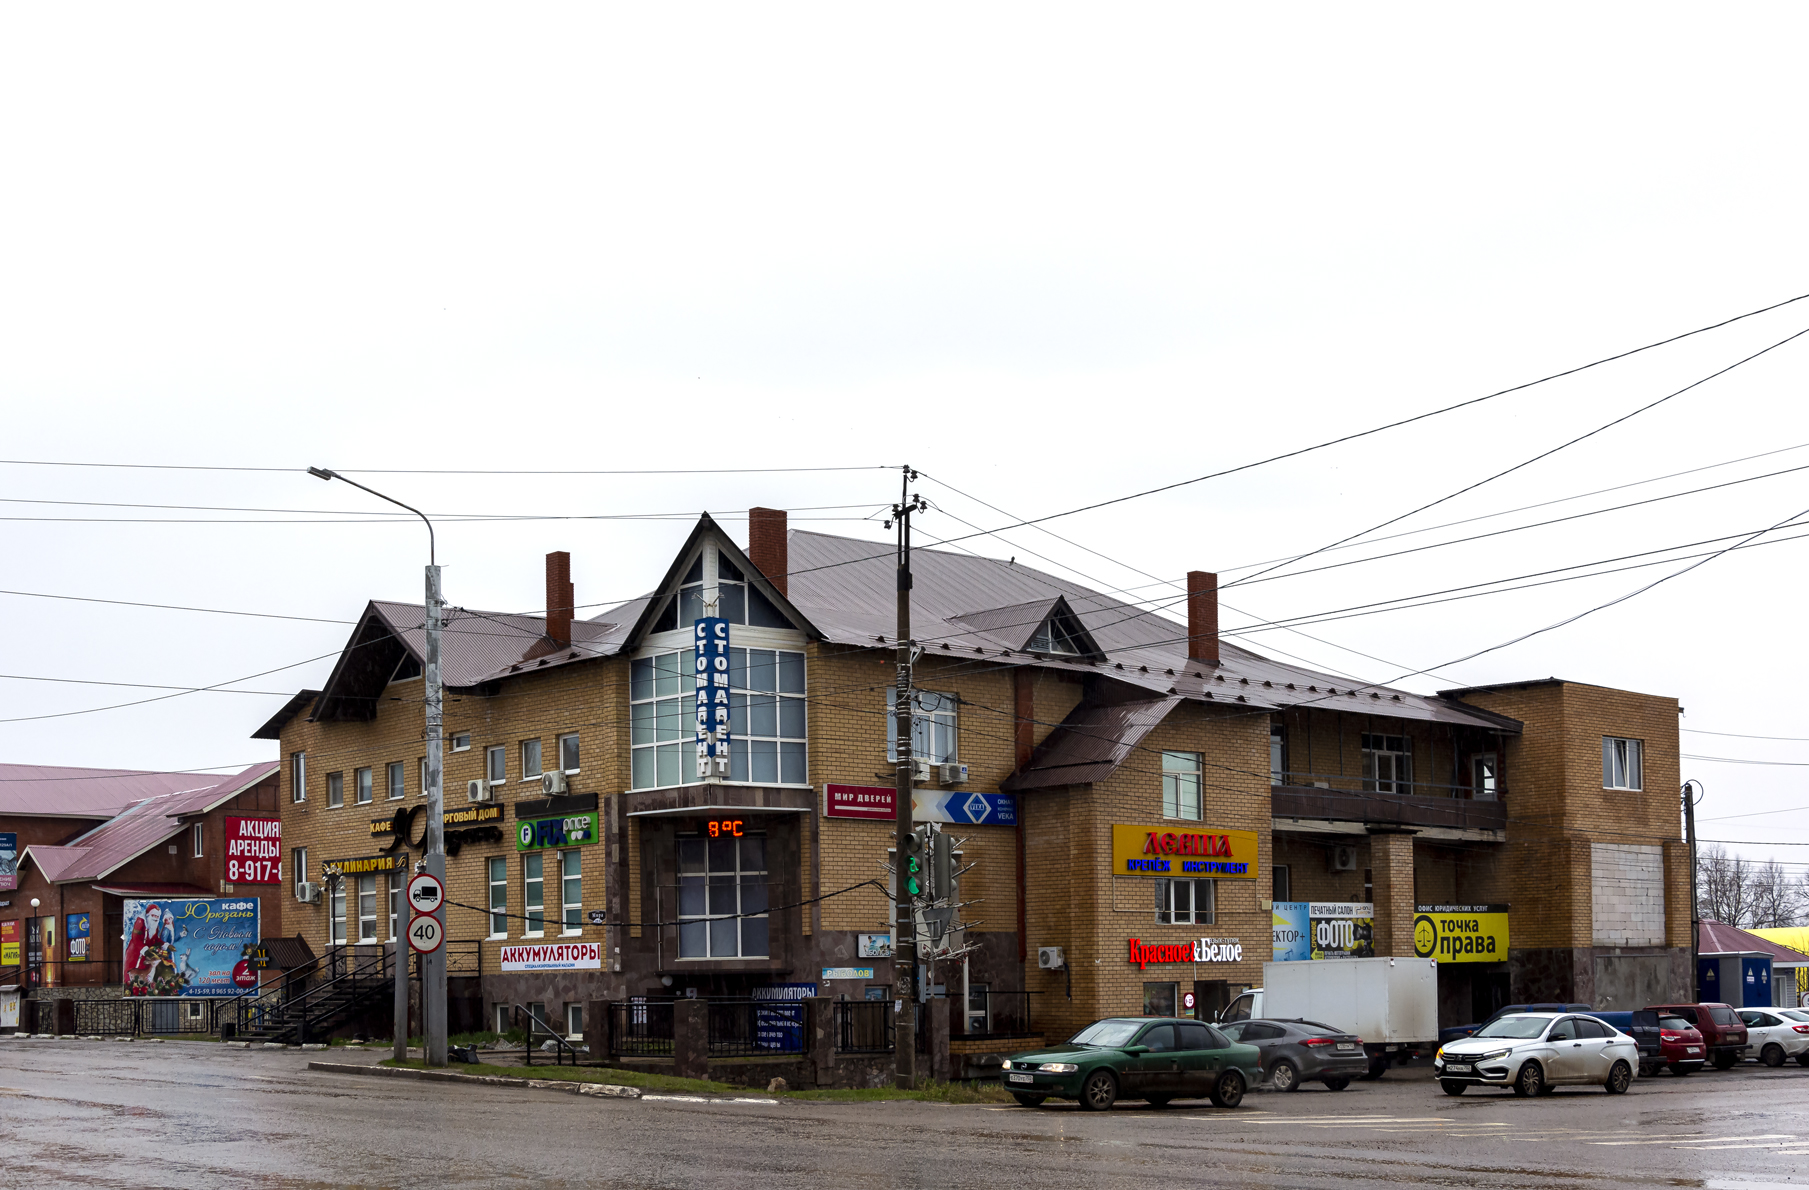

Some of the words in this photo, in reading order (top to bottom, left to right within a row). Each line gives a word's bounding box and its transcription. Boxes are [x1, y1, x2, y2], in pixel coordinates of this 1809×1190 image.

[835, 793, 854, 801] МИР
[857, 794, 891, 803] ДВЕРЕЙ
[443, 808, 478, 823] РГОВЫЙ
[478, 807, 497, 822] ДОМ
[370, 820, 392, 833] КАФЕ
[563, 816, 591, 833] price
[229, 839, 280, 858] АРЕНДЫ
[1144, 832, 1234, 857] ЛЕВША
[1127, 857, 1172, 872] КРЕПЁЖ
[1183, 861, 1249, 874] ИНСТРУМЕНТ
[177, 903, 254, 922] Юрюзань
[222, 902, 254, 910] кафе
[1310, 904, 1336, 915] ПЕЧАТНЫЙ
[1337, 905, 1354, 915] САЛОН
[413, 924, 435, 940] 40
[1317, 920, 1354, 948] ФОТО
[1440, 919, 1479, 933] точка
[70, 938, 86, 955] ФОТО
[502, 943, 601, 963] АККУМУЛЯТОРЫ
[1440, 936, 1496, 961] права
[242, 963, 250, 975] 2
[198, 977, 210, 985] 120
